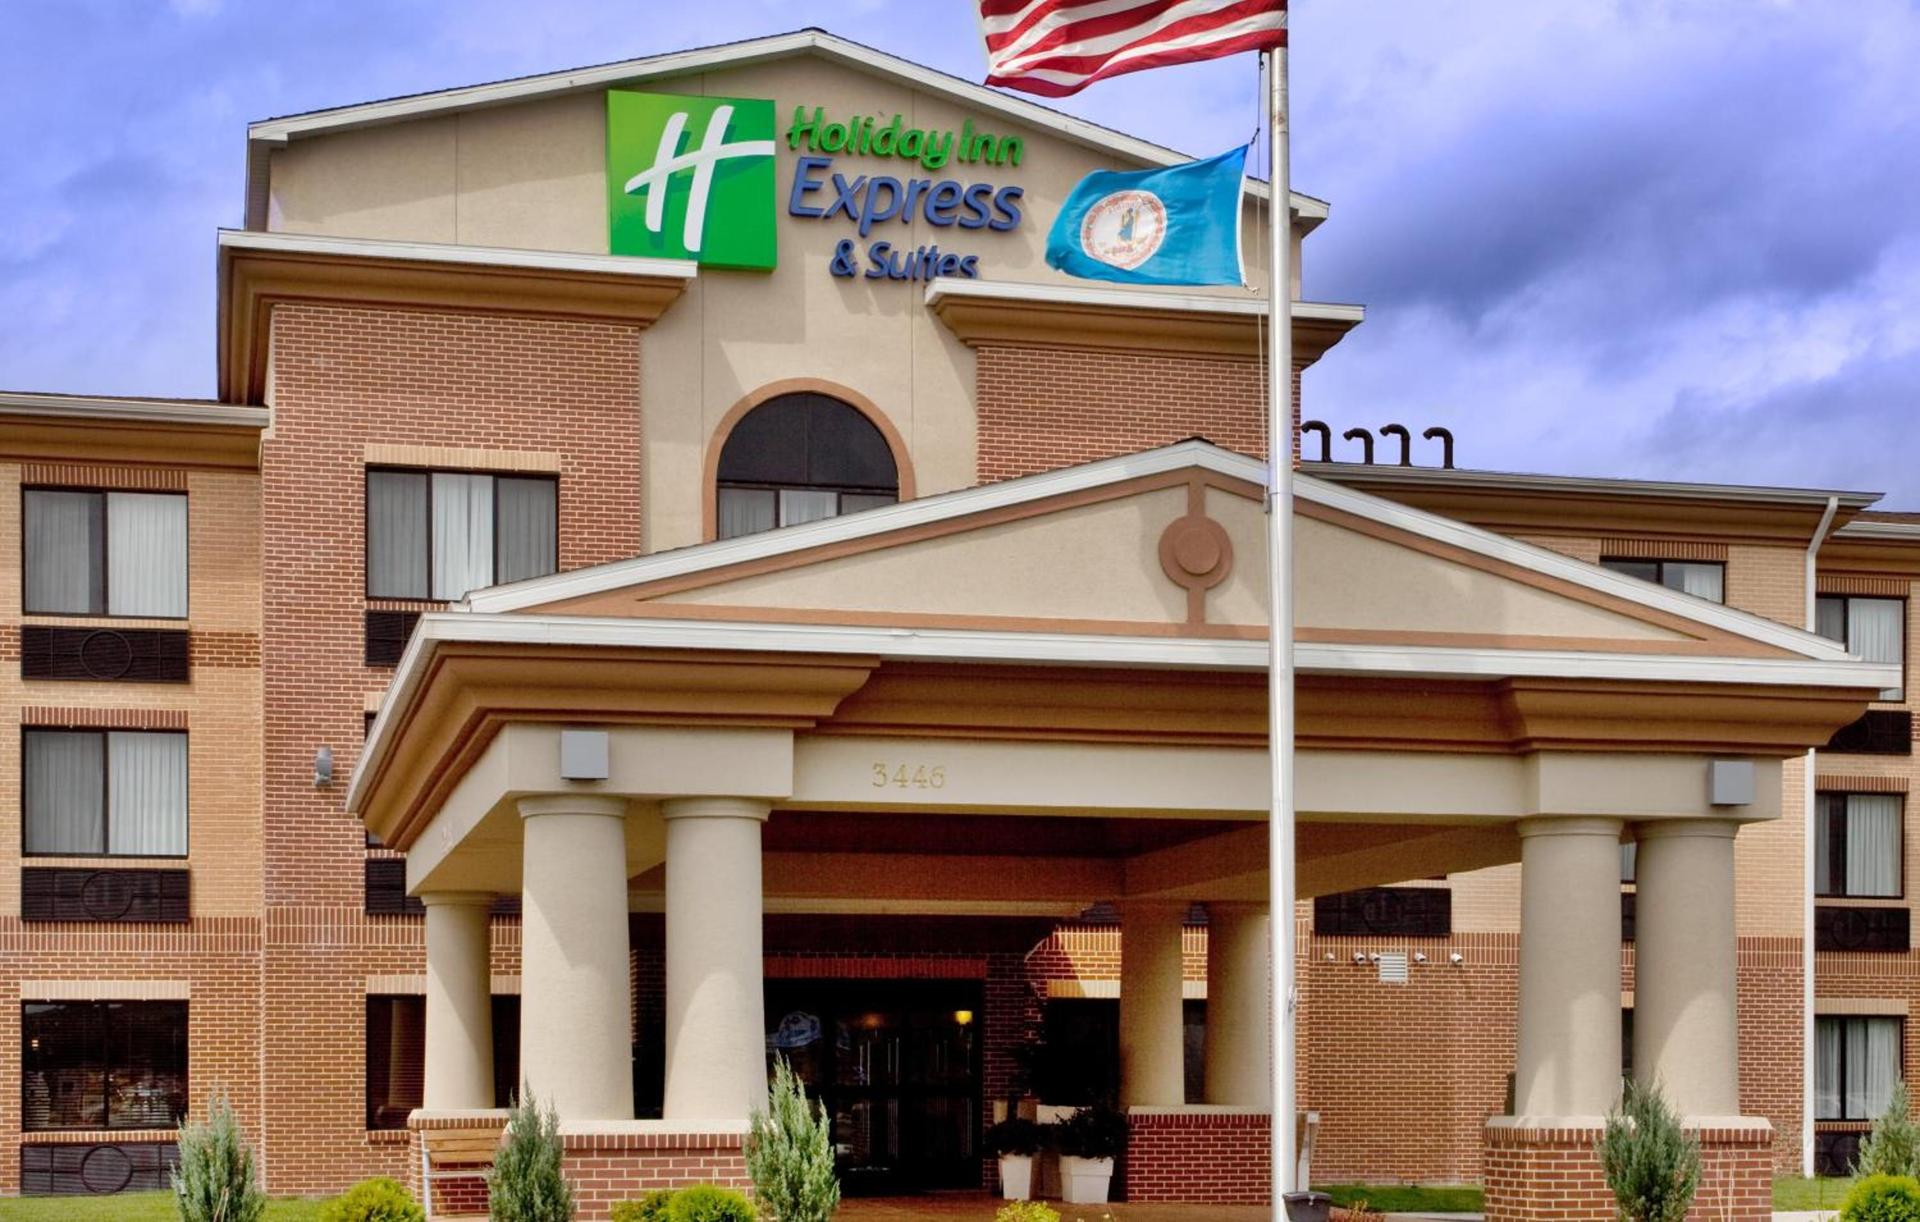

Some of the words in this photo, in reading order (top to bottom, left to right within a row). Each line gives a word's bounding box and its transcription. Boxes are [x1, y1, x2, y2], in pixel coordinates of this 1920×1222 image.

[786, 105, 952, 170] Holiday
[958, 118, 1024, 167] Inn
[625, 105, 775, 252] H
[788, 156, 1024, 238] Express
[830, 239, 857, 278] &
[865, 241, 979, 282] Suites
[872, 762, 945, 789] 3446
